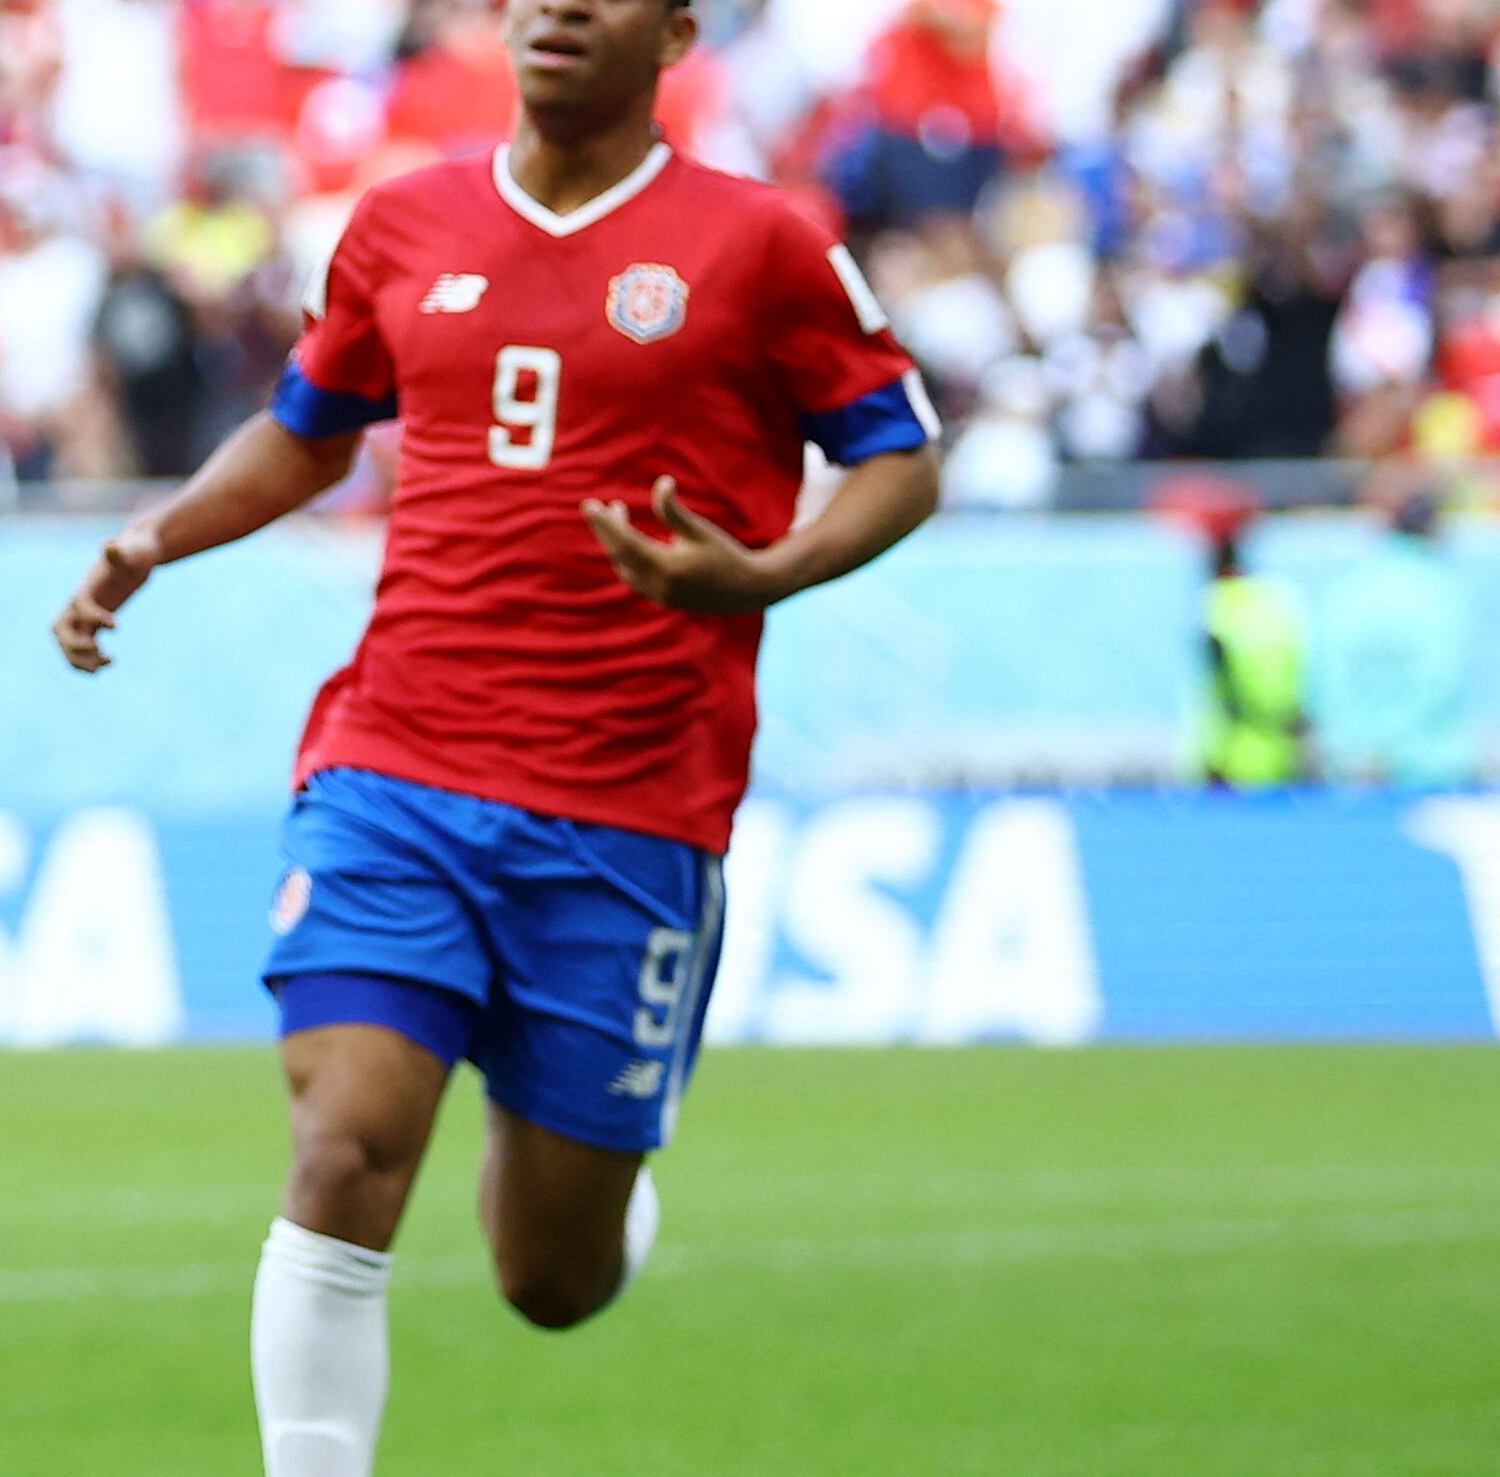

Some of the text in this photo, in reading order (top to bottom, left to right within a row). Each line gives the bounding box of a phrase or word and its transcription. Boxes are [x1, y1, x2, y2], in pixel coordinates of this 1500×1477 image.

[487, 344, 561, 471] 9
[706, 798, 1104, 1047] ISA
[632, 927, 692, 1050] 9
